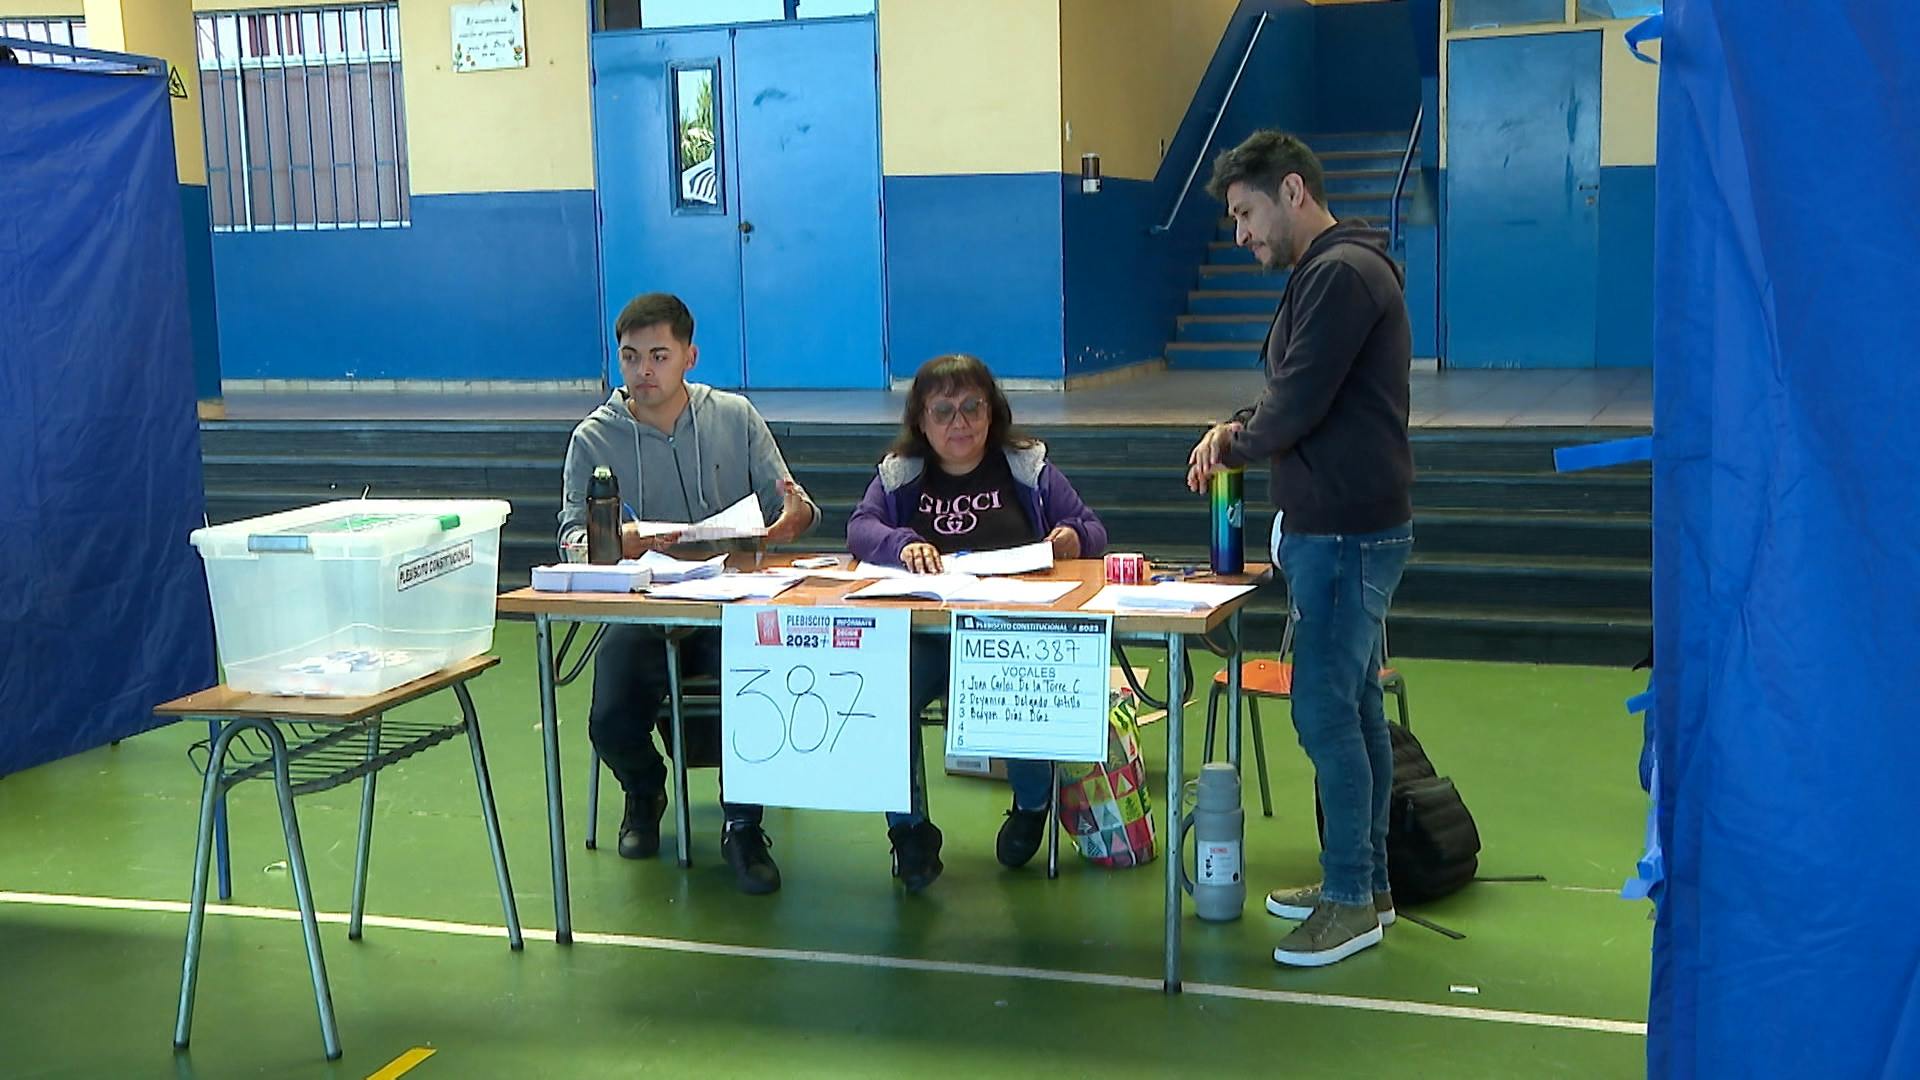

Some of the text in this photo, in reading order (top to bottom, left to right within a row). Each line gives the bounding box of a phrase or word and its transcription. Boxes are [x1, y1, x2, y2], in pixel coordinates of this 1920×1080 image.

[919, 490, 1002, 513] GUCCI
[400, 547, 470, 584] PLEBISCITO CONSTITUCIONAL
[786, 615, 830, 626] PLEBISCITO
[1012, 623, 1068, 632] CONSTITUCIONAL
[786, 635, 819, 648] 2023
[965, 639, 1080, 664] MESA: 387
[1002, 666, 1056, 679] VOCALES
[729, 665, 876, 764] 387
